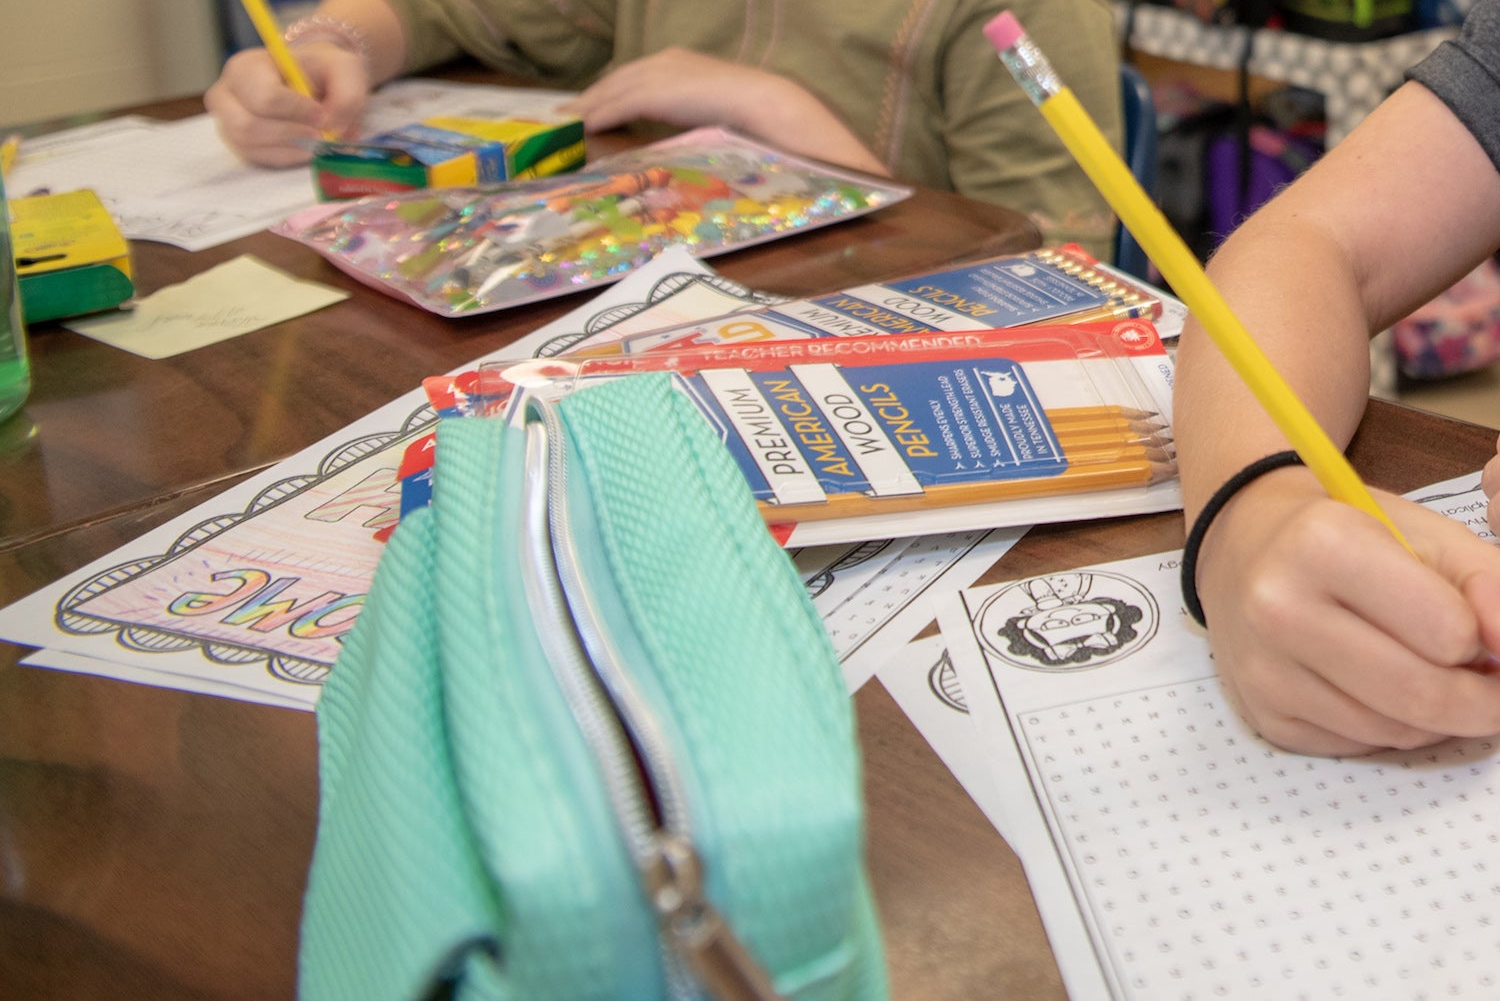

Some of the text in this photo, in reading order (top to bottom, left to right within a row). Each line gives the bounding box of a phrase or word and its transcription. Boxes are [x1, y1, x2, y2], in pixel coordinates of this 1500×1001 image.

[884, 296, 955, 325] WOOD
[907, 284, 999, 317] PENCILS
[703, 334, 981, 362] TEACHER RECOMMENDED
[723, 388, 804, 476] PREMIUM
[763, 379, 855, 477] AMERICAN
[823, 393, 885, 456] WOOD
[860, 383, 939, 458] PENCILS
[928, 399, 962, 460] SHARPENS EVENLY
[959, 423, 982, 459] SUPERIOR
[999, 403, 1034, 459] PROUDLY MADE
[1016, 403, 1044, 443] TENNESSEE
